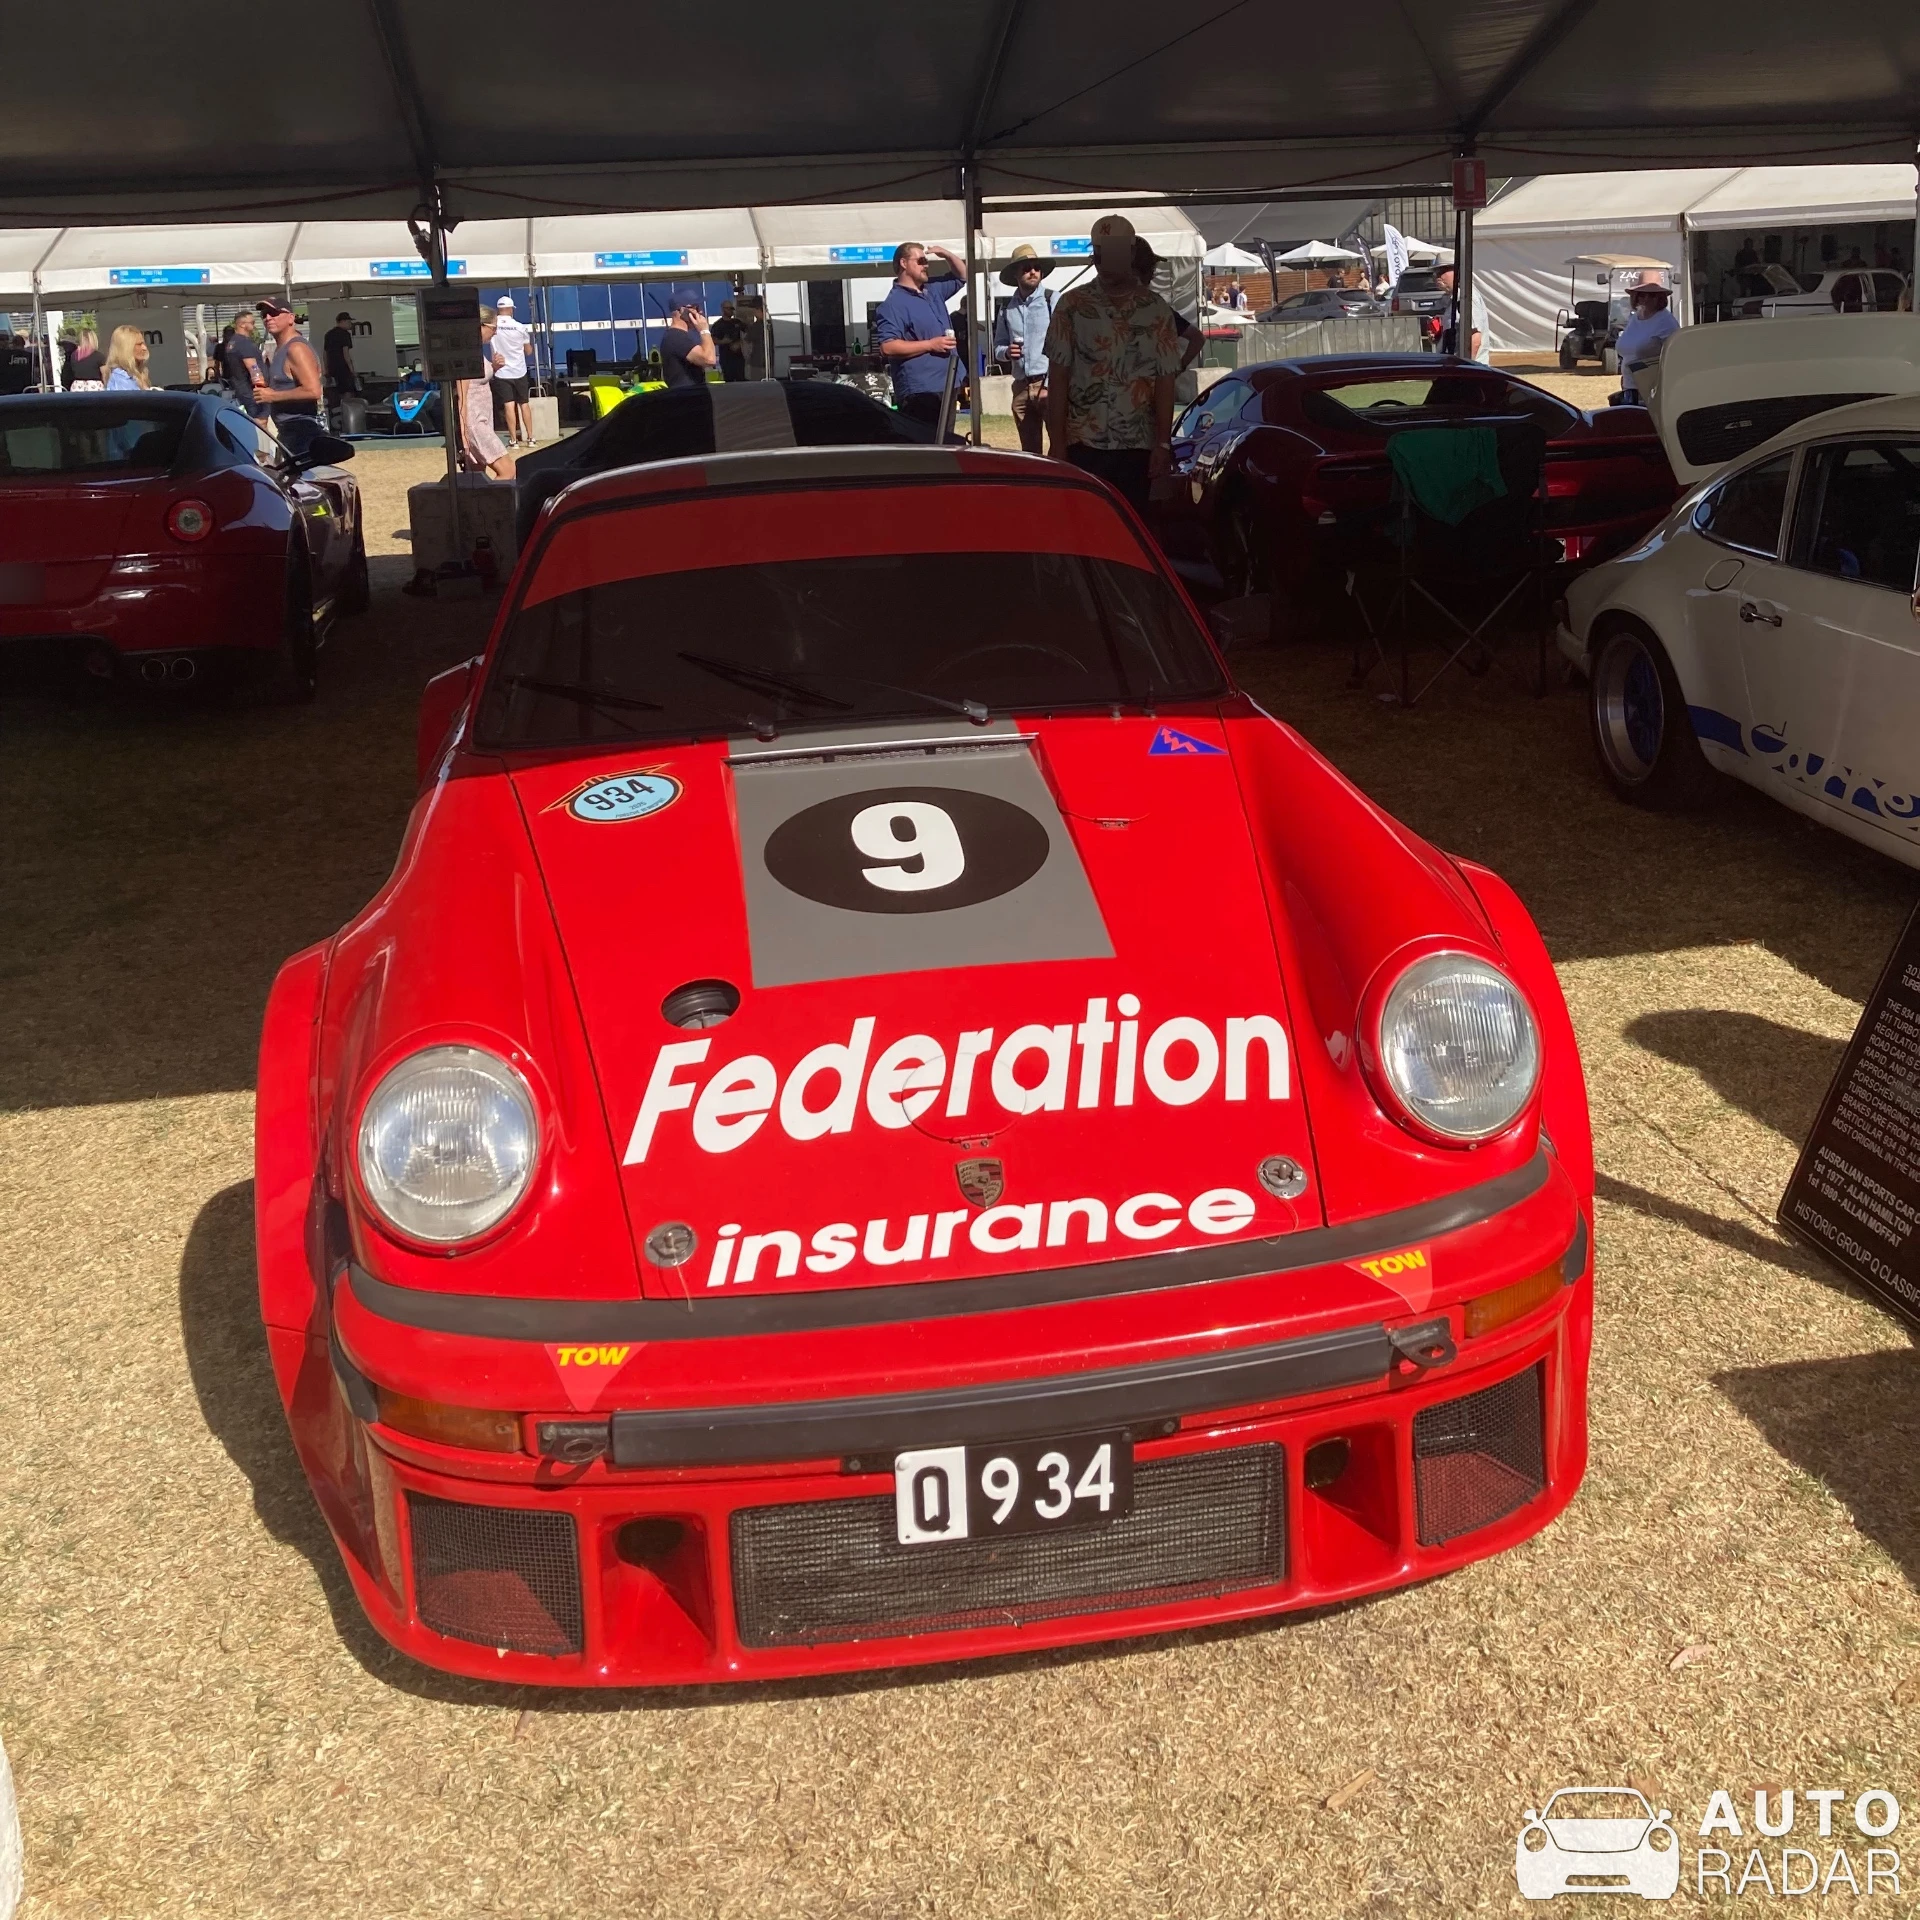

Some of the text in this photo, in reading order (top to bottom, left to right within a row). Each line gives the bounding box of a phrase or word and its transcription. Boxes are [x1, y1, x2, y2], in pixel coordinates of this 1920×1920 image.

[583, 778, 655, 811] 934
[850, 801, 964, 892] 9
[1880, 1010, 1919, 1038] 911 TURBO
[1886, 997, 1903, 1014] THE
[1901, 1006, 1915, 1021] 934
[1869, 1033, 1890, 1052] ROAD
[1890, 1046, 1907, 1061] CAR
[1905, 1055, 1915, 1066] IS
[1888, 1061, 1906, 1077] AND
[1906, 1071, 1919, 1084] BY
[621, 992, 1291, 1167] Federation
[1848, 1080, 1873, 1102] TURBO
[1852, 1068, 1895, 1101] PORSCHES
[1857, 1057, 1911, 1096] APPROACHING
[1836, 1104, 1883, 1140] PARTICULAR
[1882, 1135, 1897, 1151] 934
[1897, 1144, 1907, 1157] IS
[1841, 1092, 1872, 1117] BRAKES
[1870, 1111, 1888, 1128] ARE
[1885, 1121, 1910, 1143] FROM
[1831, 1116, 1853, 1135] MOST
[1851, 1129, 1884, 1159] ORIGINAL
[1883, 1151, 1894, 1164] IN
[1892, 1156, 1909, 1175] THE
[1813, 1159, 1826, 1175] 1st
[1826, 1168, 1845, 1187] 1977
[1846, 1183, 1870, 1207] ALAN
[1869, 1198, 1913, 1237] HAMILTON
[1817, 1145, 1864, 1183] AUSRALIAN
[1861, 1175, 1896, 1207] SPORTS
[1894, 1199, 1915, 1220] CAR
[1807, 1172, 1820, 1189] 1st
[1820, 1182, 1838, 1202] 1980
[1840, 1197, 1869, 1224] ALLAN
[1867, 1216, 1902, 1248] MOFFAT
[705, 1187, 1256, 1288] insurance
[1794, 1199, 1920, 1305] HISTORIC GROUP Q CLASSIF
[1360, 1249, 1427, 1278] TOW
[557, 1346, 631, 1367] TOW
[912, 1443, 1115, 1534] Q 934
